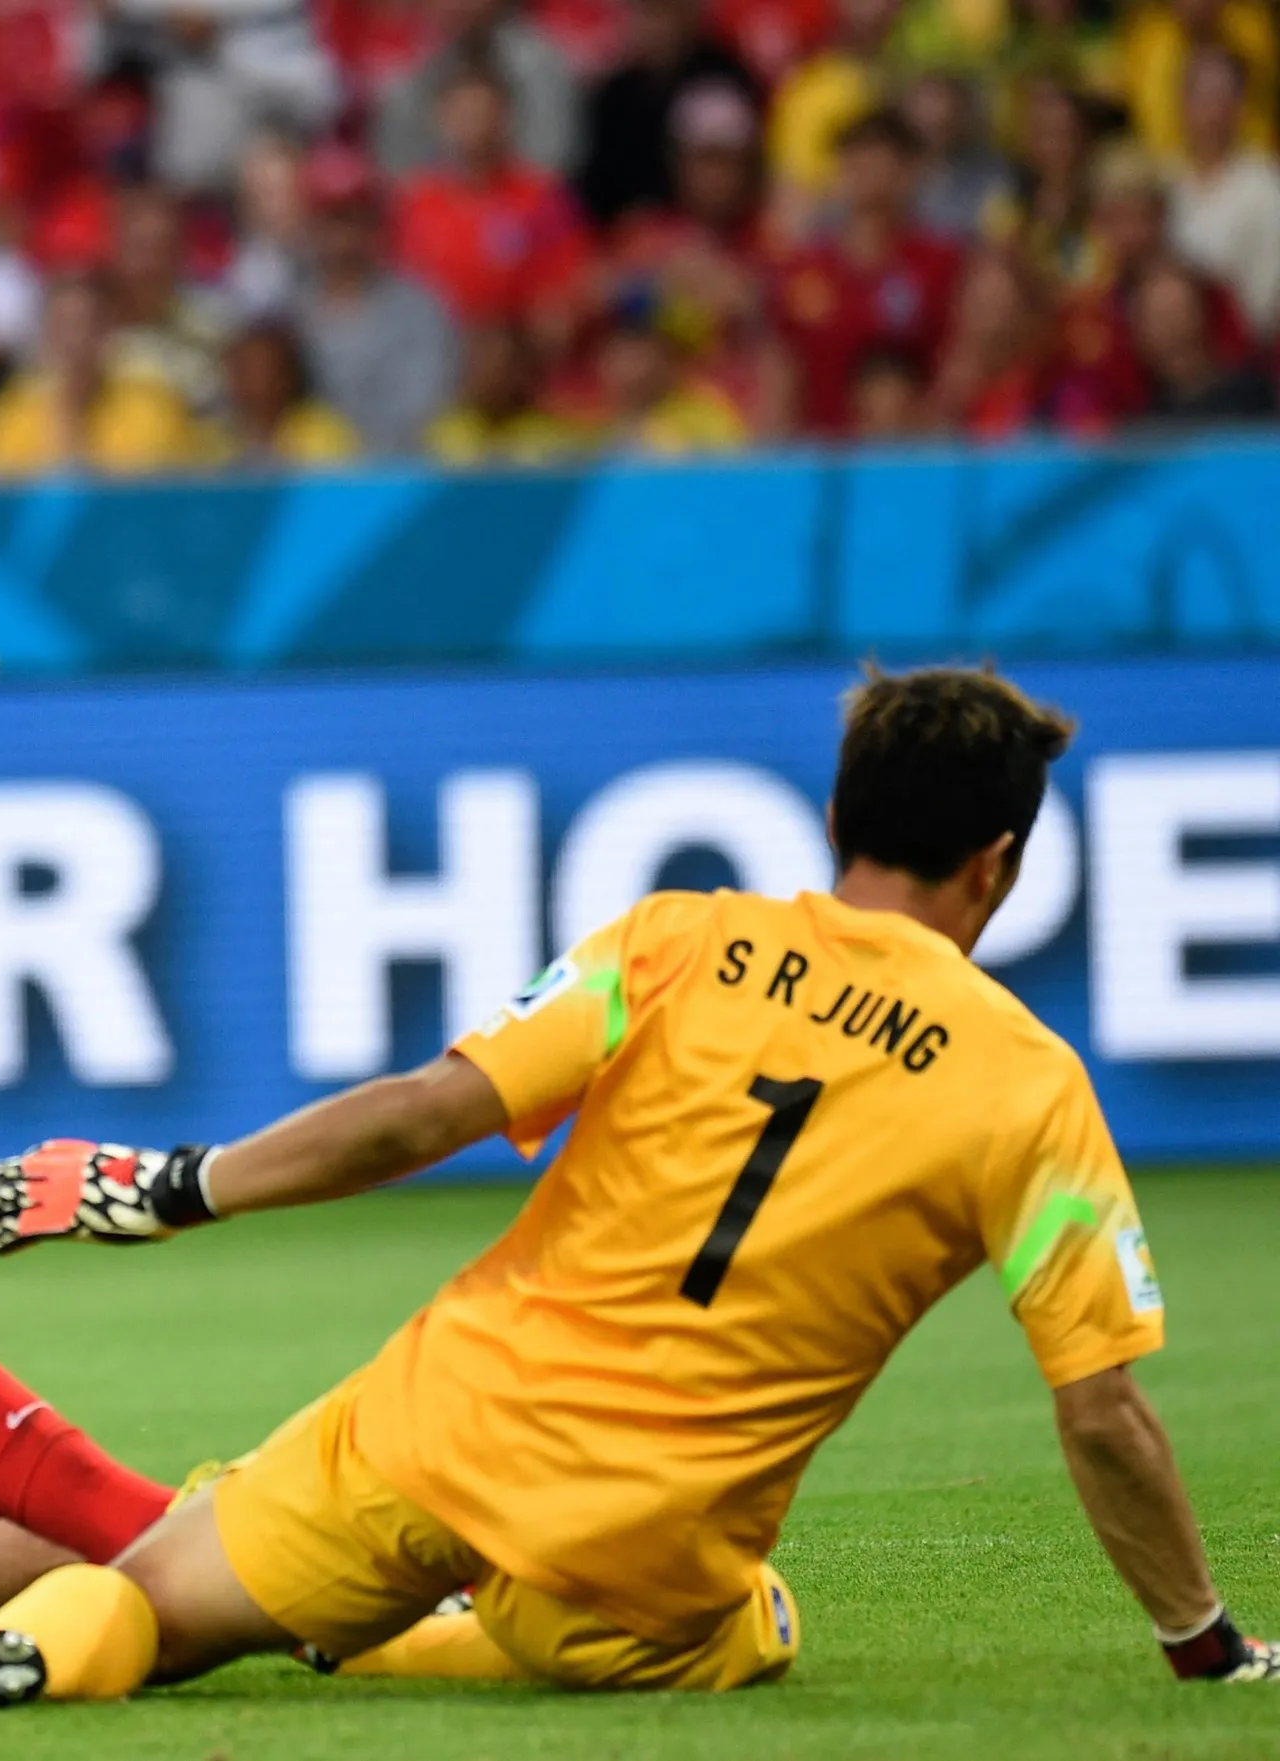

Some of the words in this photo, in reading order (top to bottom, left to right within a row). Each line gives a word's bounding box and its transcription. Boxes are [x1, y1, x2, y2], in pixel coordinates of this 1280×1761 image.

[717, 939, 753, 985] S
[766, 950, 808, 1006] R
[809, 985, 949, 1074] JUNG
[681, 1073, 824, 1309] 1
